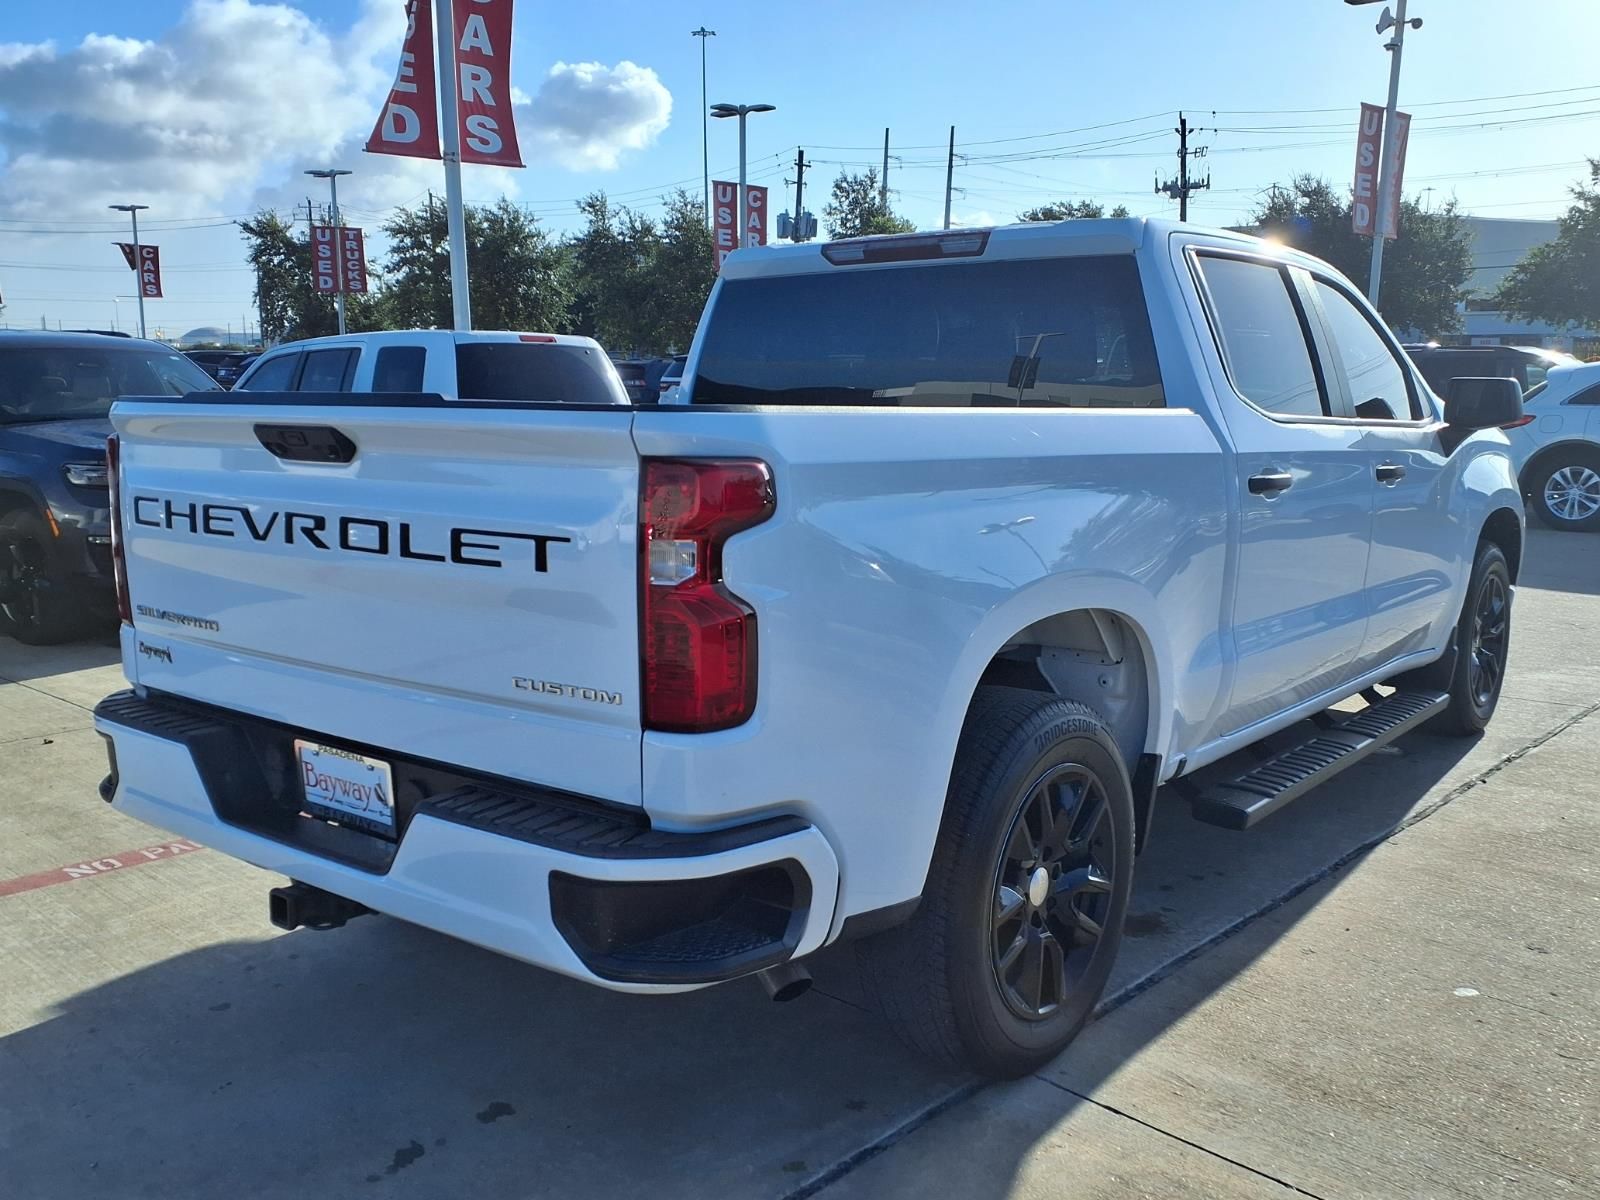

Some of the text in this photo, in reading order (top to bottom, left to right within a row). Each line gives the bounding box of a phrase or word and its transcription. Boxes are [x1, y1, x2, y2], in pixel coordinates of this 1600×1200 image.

[459, 0, 503, 154] ARS
[1355, 110, 1379, 227] USED
[142, 247, 158, 295] CARS
[316, 228, 334, 289] USED
[344, 230, 362, 290] TRUCKS
[133, 495, 571, 573] CHEVROLET
[511, 676, 623, 706] CUSTOM
[1034, 718, 1100, 753] BRIDGESTONE
[302, 760, 372, 812] Bayway
[62, 858, 123, 878] NO
